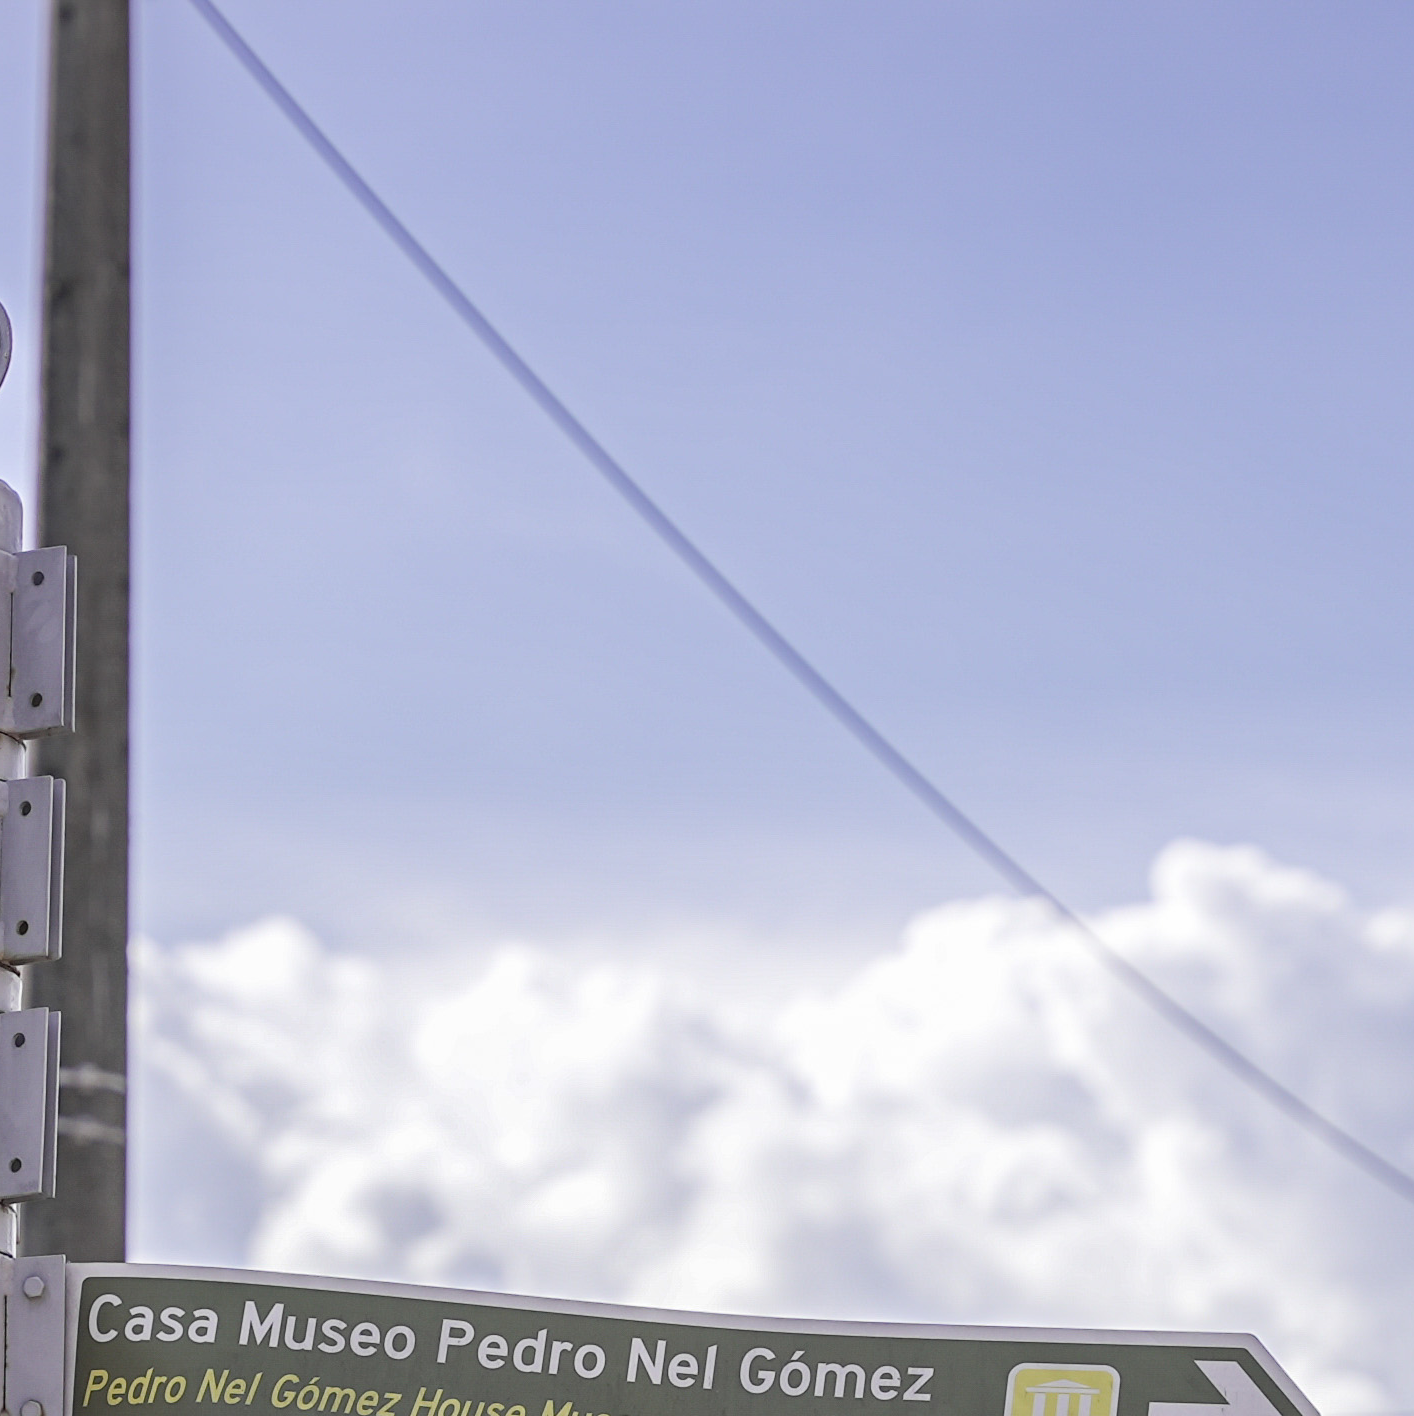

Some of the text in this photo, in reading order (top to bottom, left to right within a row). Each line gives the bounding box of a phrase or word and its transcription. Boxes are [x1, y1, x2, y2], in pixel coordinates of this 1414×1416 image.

[88, 1293, 935, 1402] Casa Museo Pedro Nel Gómez
[82, 1367, 187, 1407] Pedro
[195, 1368, 263, 1406] Nel
